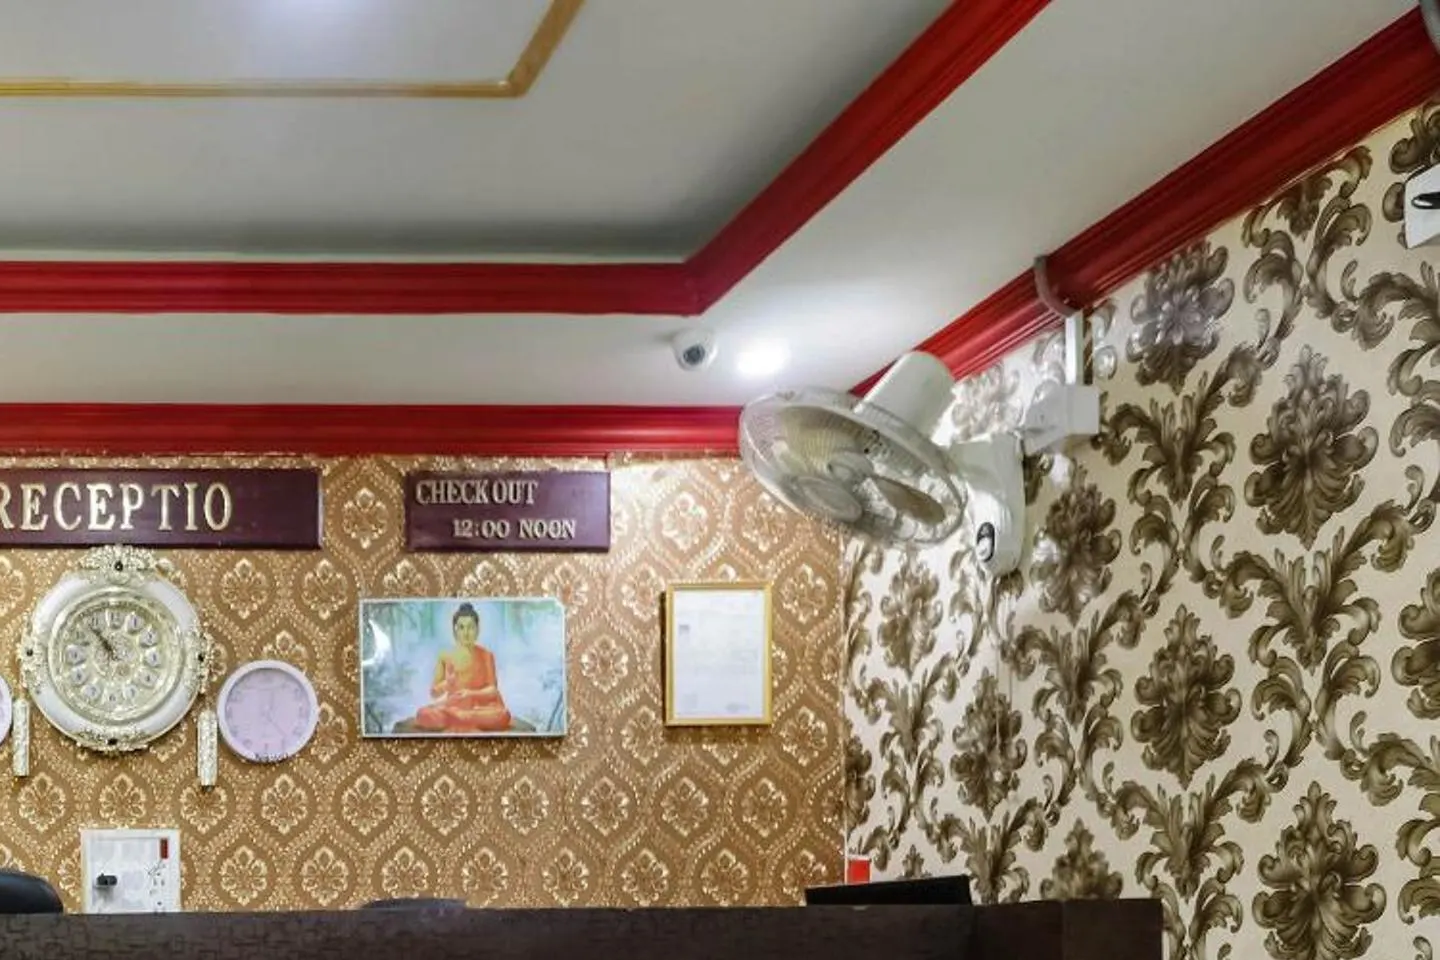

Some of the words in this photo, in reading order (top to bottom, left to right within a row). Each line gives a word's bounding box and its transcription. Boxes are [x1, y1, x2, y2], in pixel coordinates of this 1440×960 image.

[416, 479, 489, 504] CHECK
[492, 479, 539, 504] OUT
[453, 519, 510, 538] 12:00
[518, 518, 577, 539] NOON
